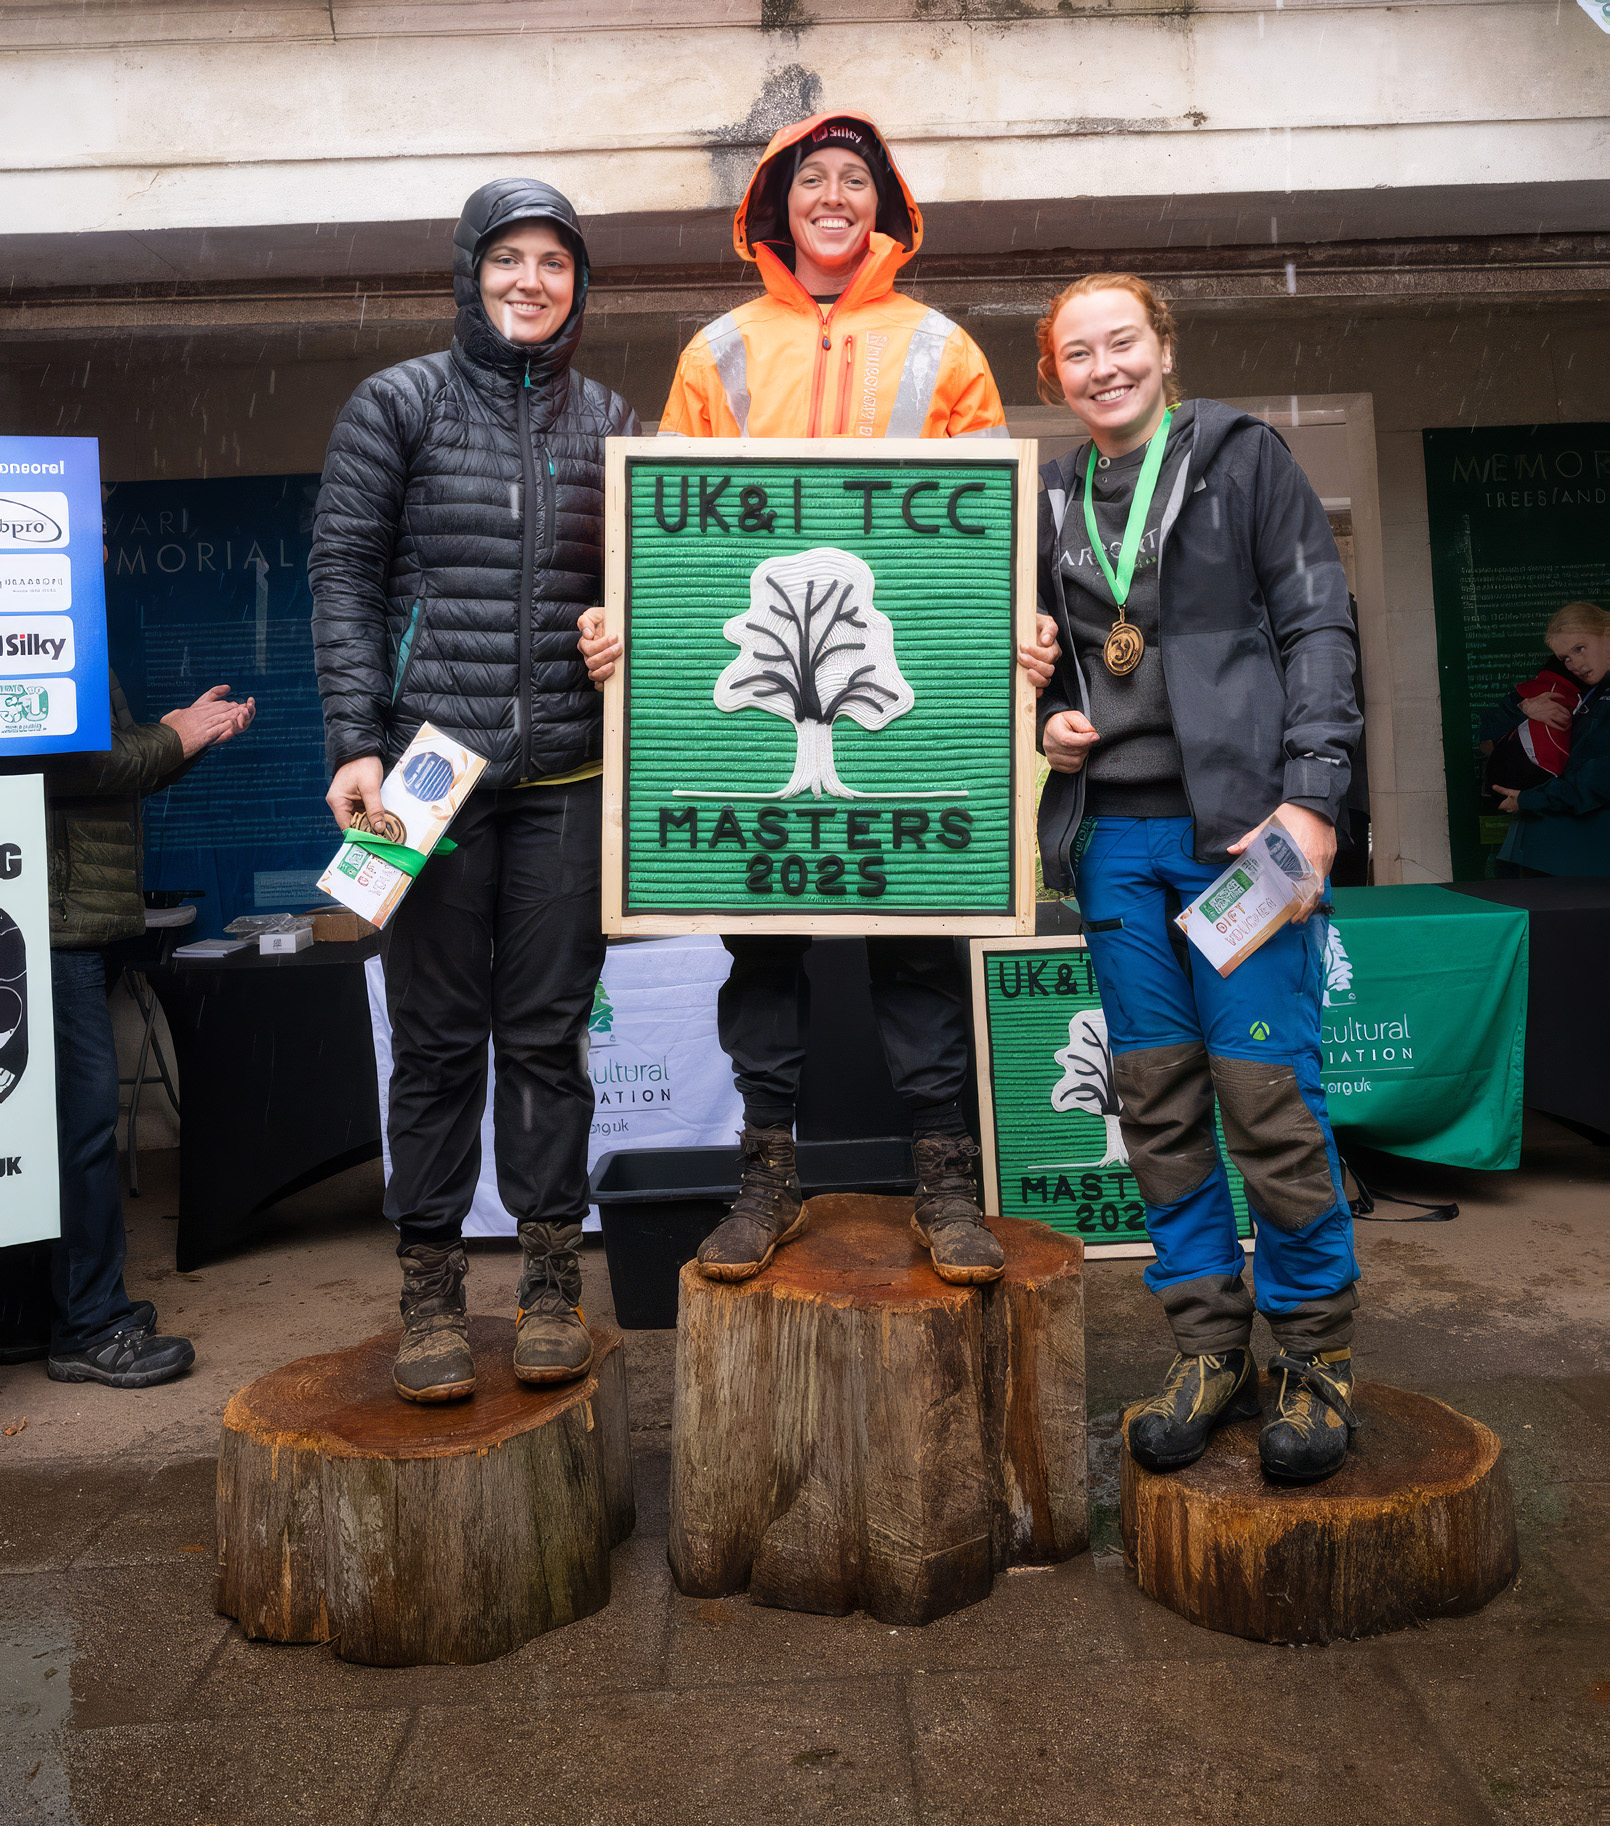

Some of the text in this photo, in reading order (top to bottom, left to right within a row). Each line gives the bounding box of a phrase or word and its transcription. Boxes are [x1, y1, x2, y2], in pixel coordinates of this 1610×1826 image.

[655, 475, 987, 534] UK&I TCC
[6, 633, 66, 660] Silky
[659, 806, 973, 850] MASTERS
[745, 854, 887, 897] 2025
[589, 1055, 670, 1085] ultural
[600, 1088, 671, 1105] ATION
